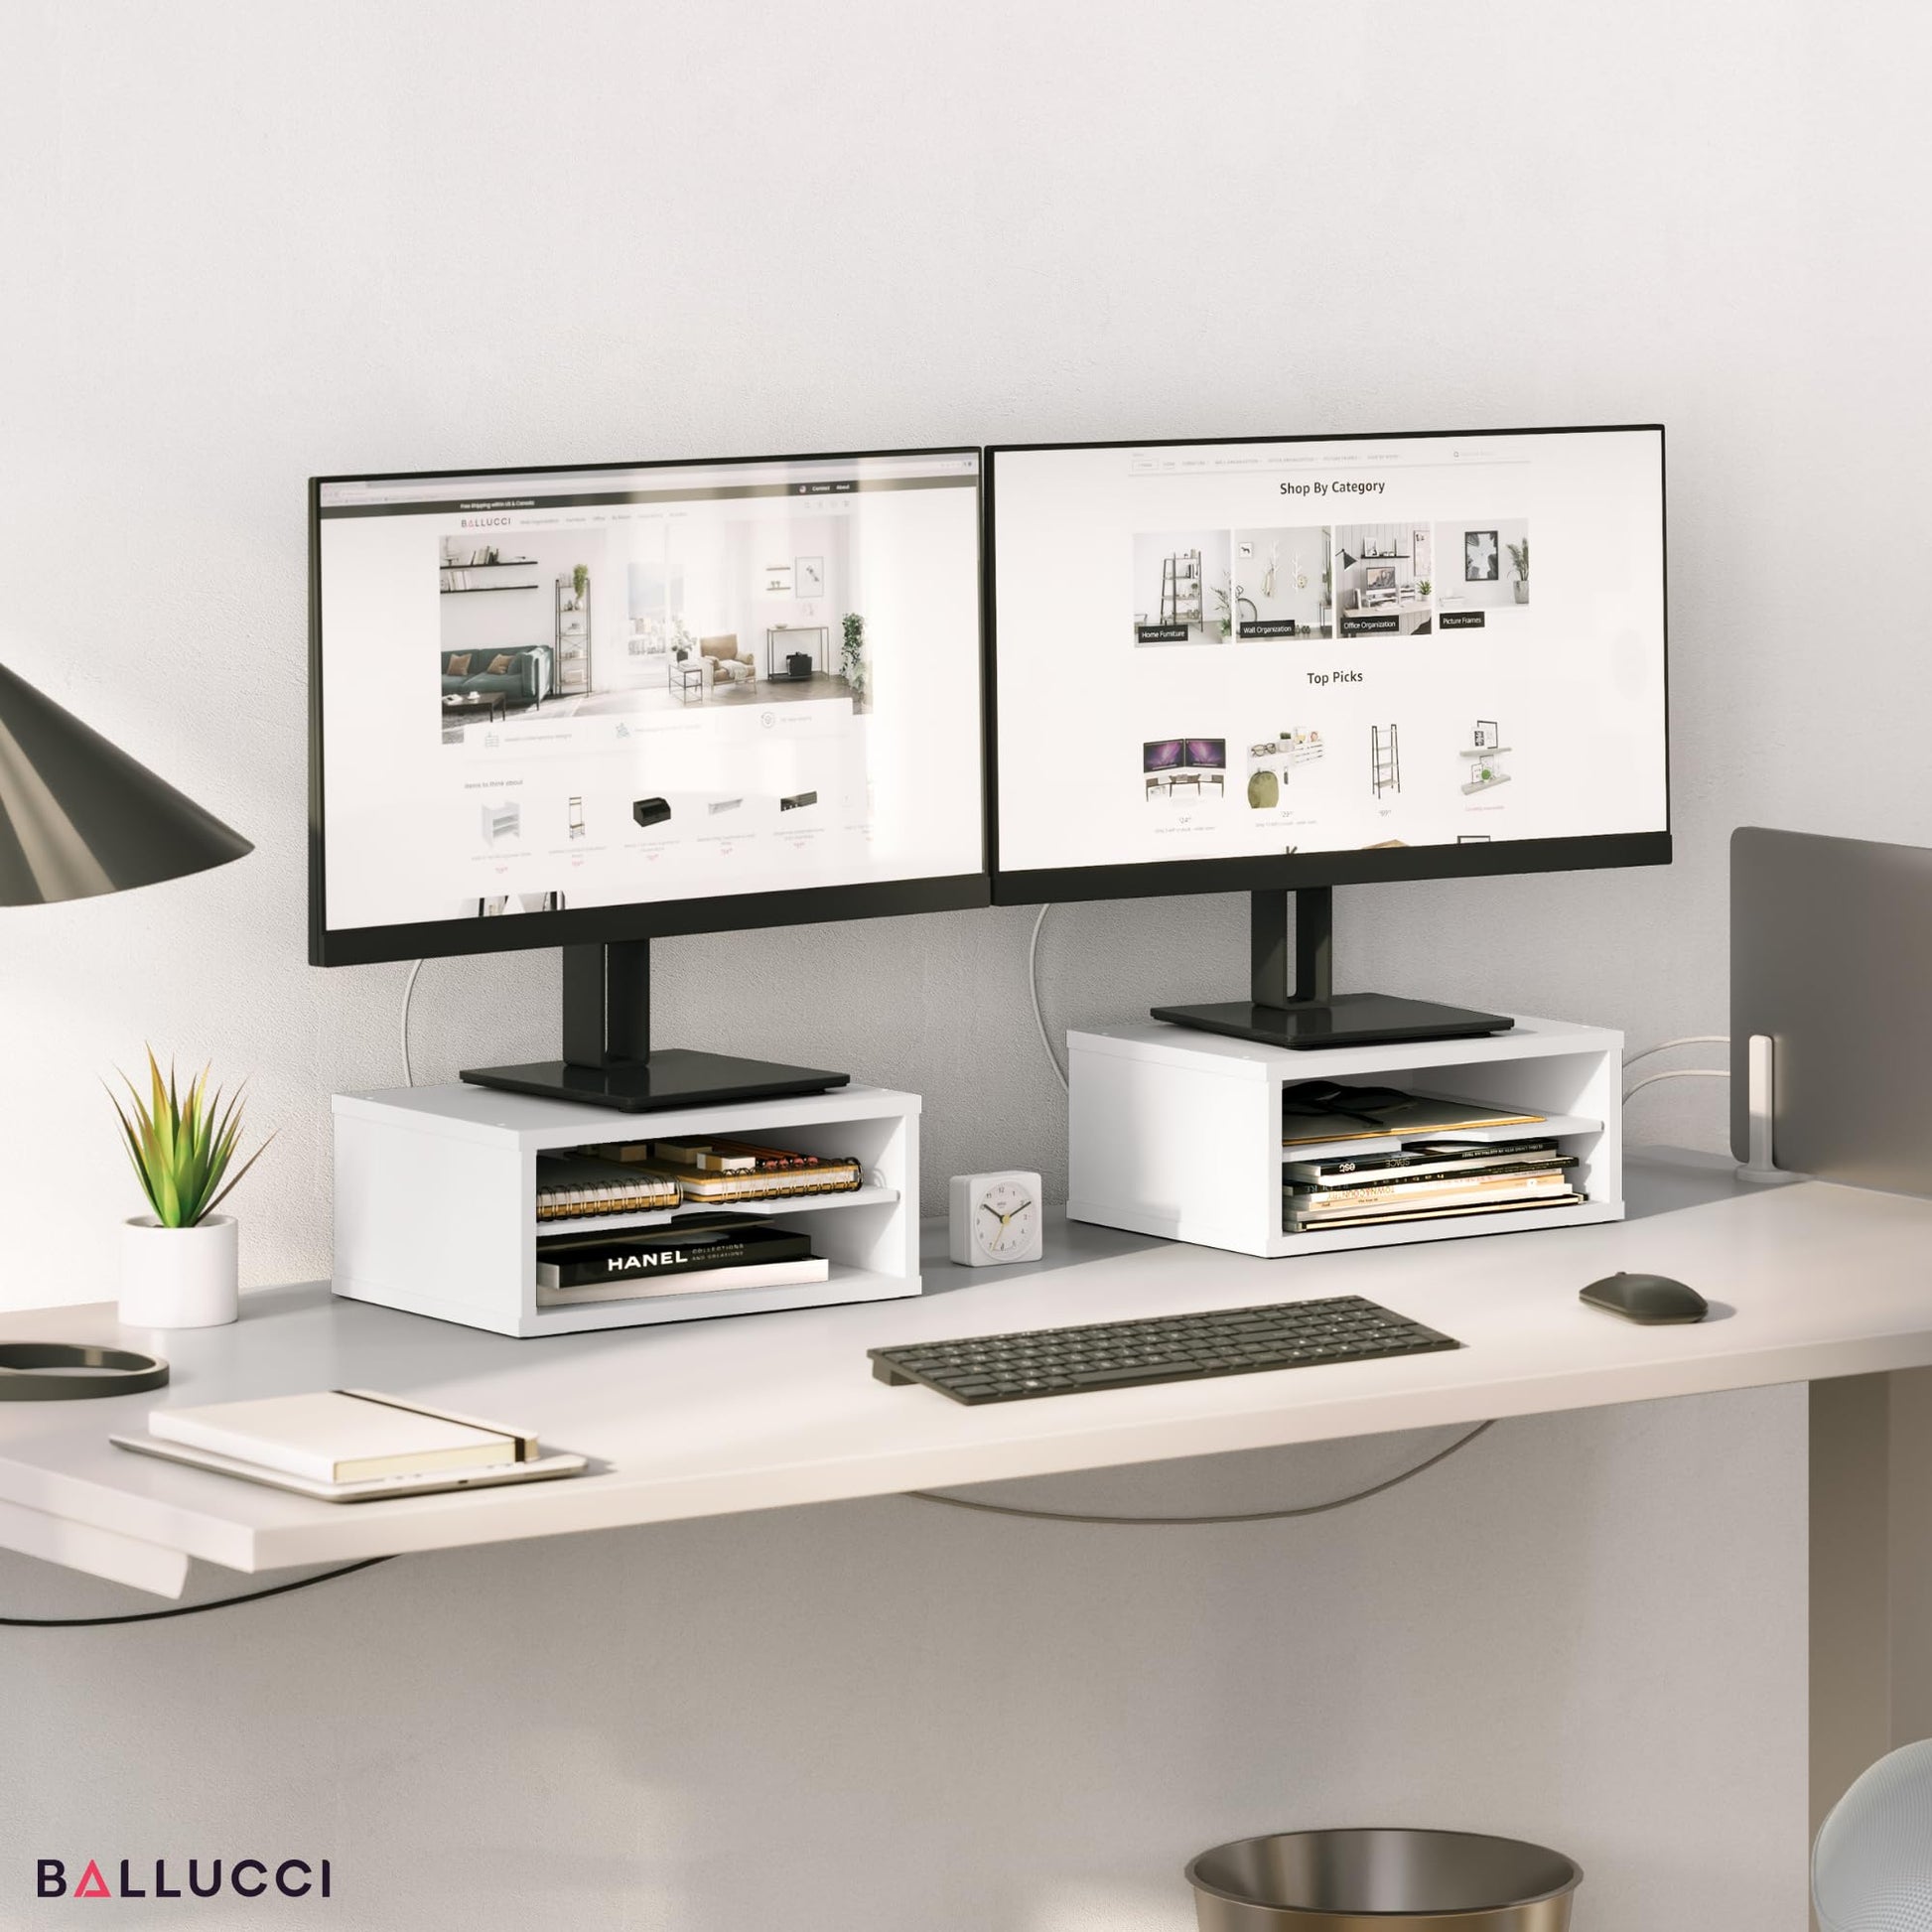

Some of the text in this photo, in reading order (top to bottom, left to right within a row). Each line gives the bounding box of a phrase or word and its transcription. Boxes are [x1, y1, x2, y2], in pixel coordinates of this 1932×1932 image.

[1280, 482, 1385, 496] Shop By Category
[461, 517, 511, 528] BALLUCCI
[1257, 625, 1292, 634] Organization
[1361, 621, 1396, 629] Organization
[1308, 670, 1363, 685] Top Picks
[608, 1250, 688, 1272] HANEL
